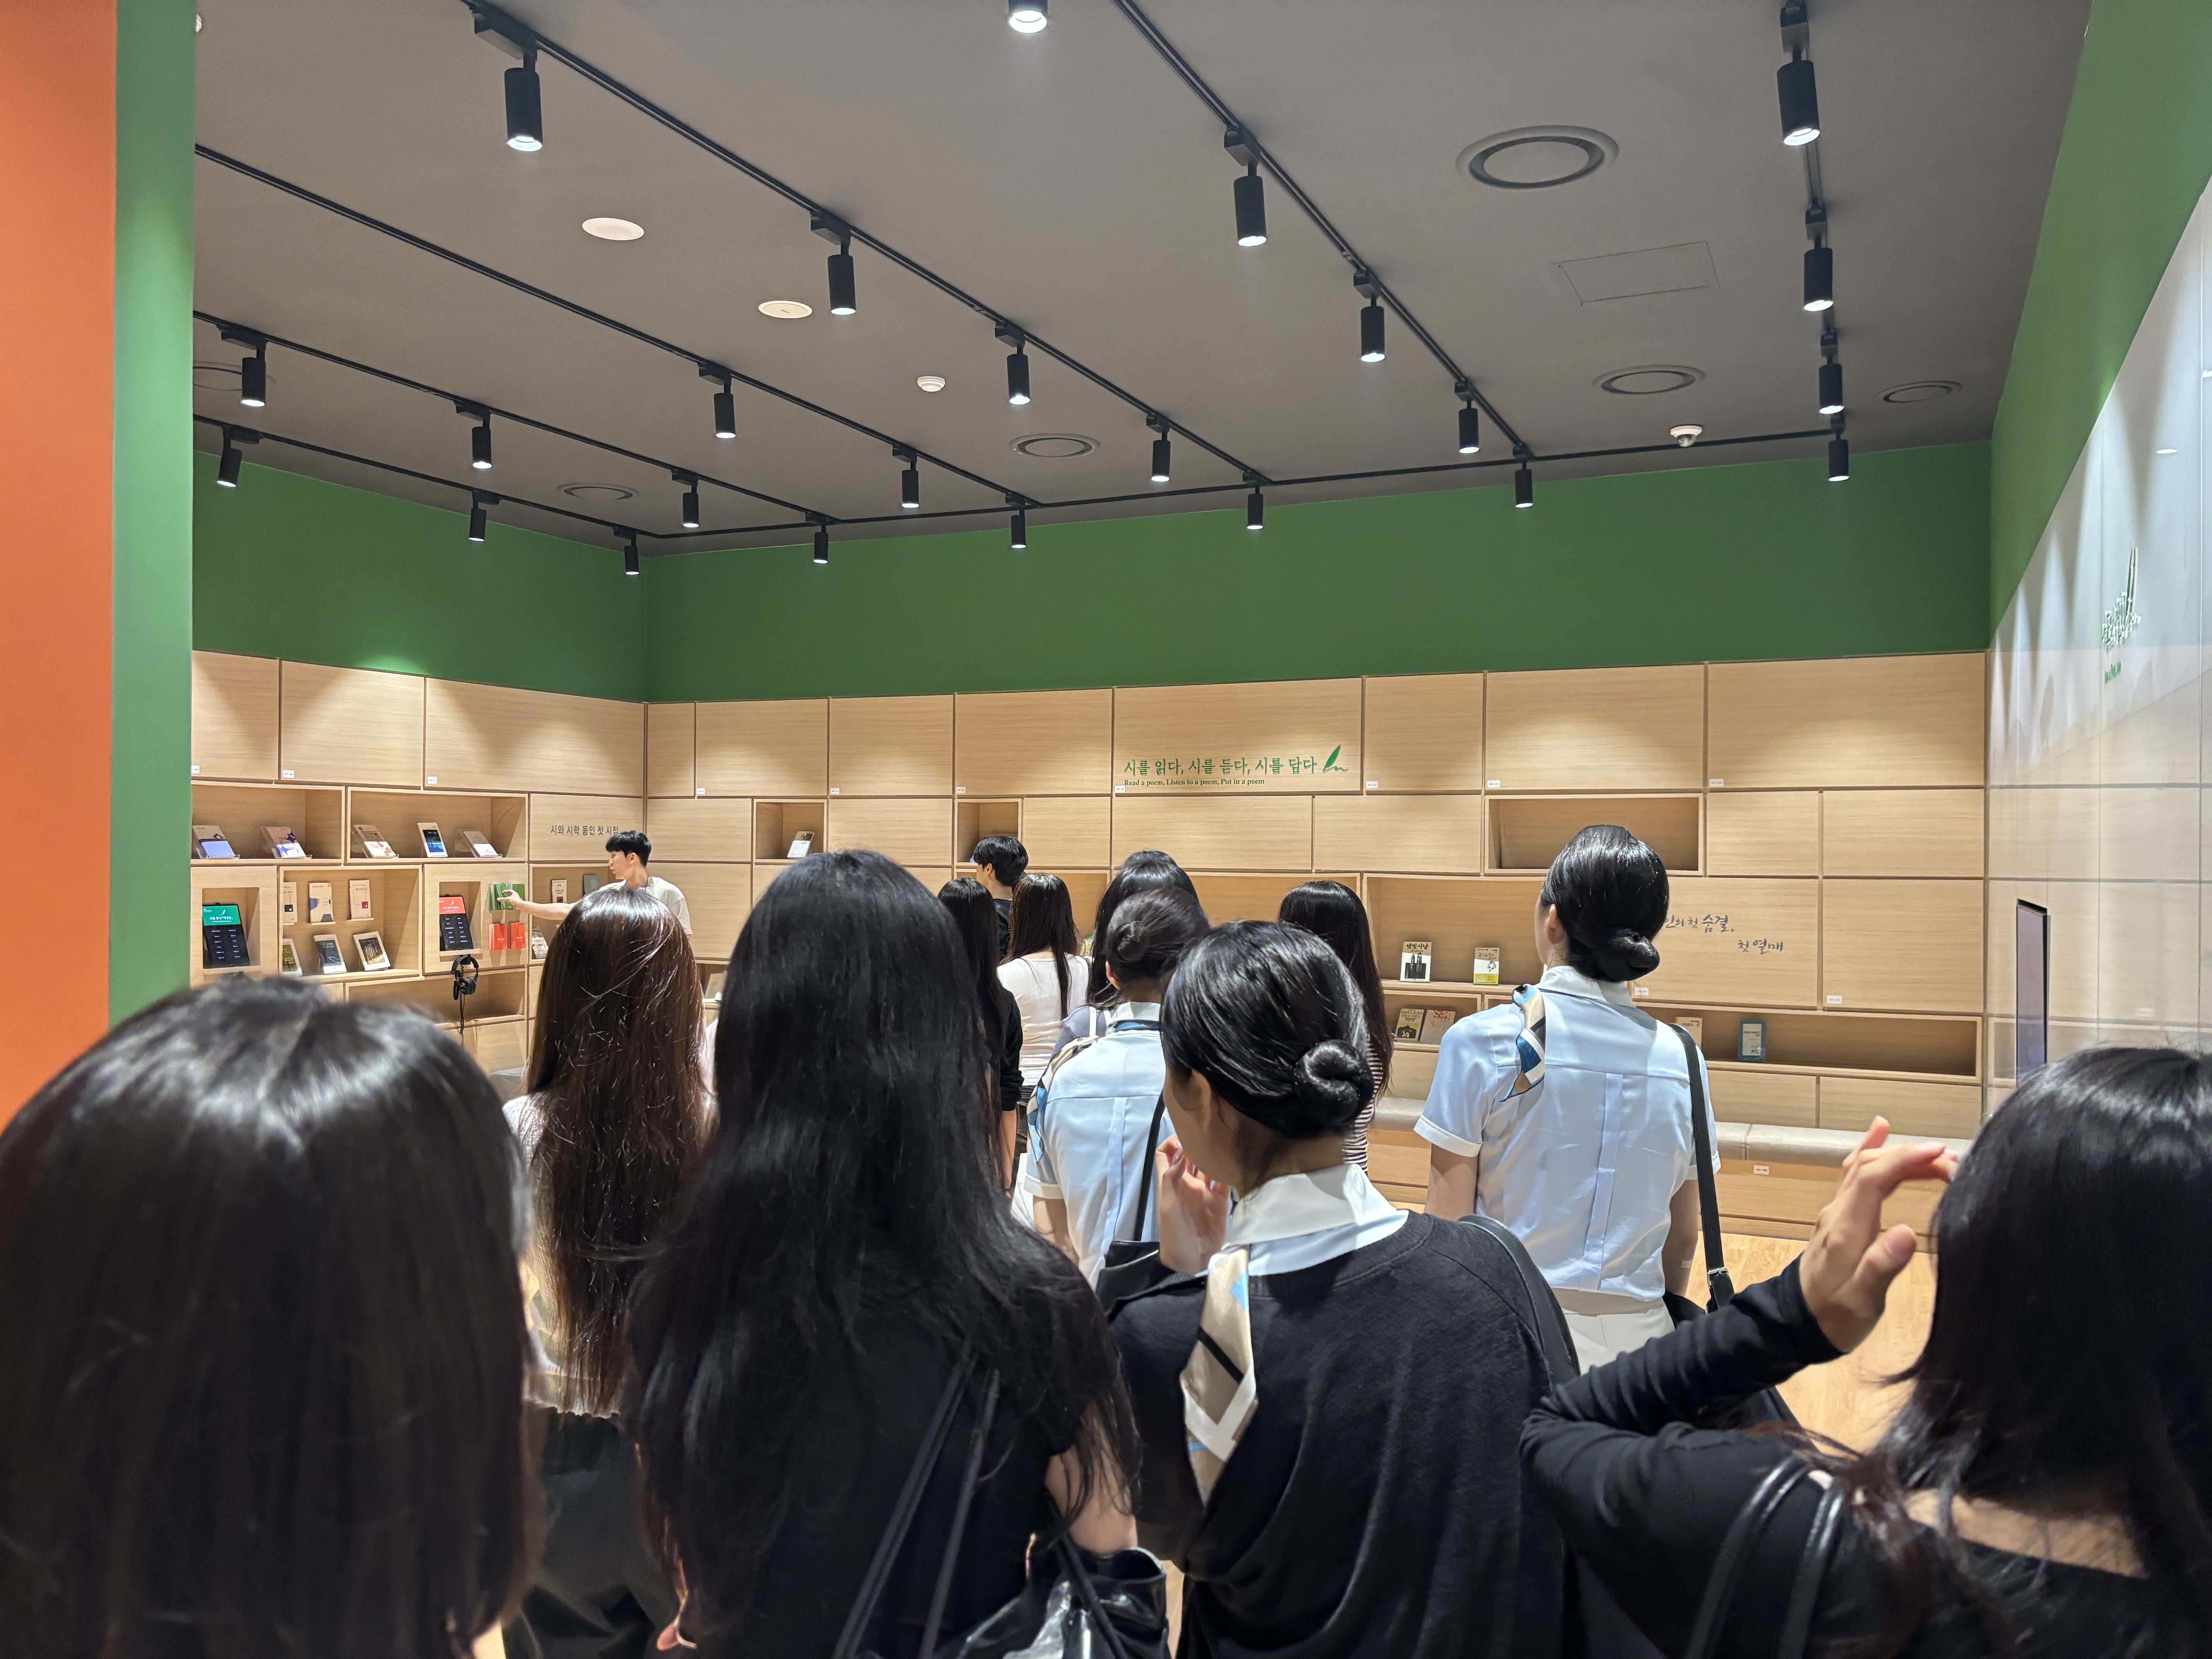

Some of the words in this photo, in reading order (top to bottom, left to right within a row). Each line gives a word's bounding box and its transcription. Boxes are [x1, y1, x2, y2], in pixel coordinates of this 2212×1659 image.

[1124, 759, 1150, 776] 시를
[1155, 759, 1183, 775] 읽다,
[1188, 759, 1215, 775] 시를
[1219, 757, 1250, 775] 듣다,
[1255, 757, 1283, 775] 시를
[1288, 756, 1317, 774] 담다
[551, 825, 564, 835] 시와
[567, 825, 580, 835] 시학
[582, 826, 595, 835] 동인
[598, 826, 603, 835] 첫
[1688, 917, 1698, 929] 첫
[1701, 914, 1734, 933] 숨결,
[1738, 939, 1749, 952] 첫
[1753, 938, 1783, 955] 열매
